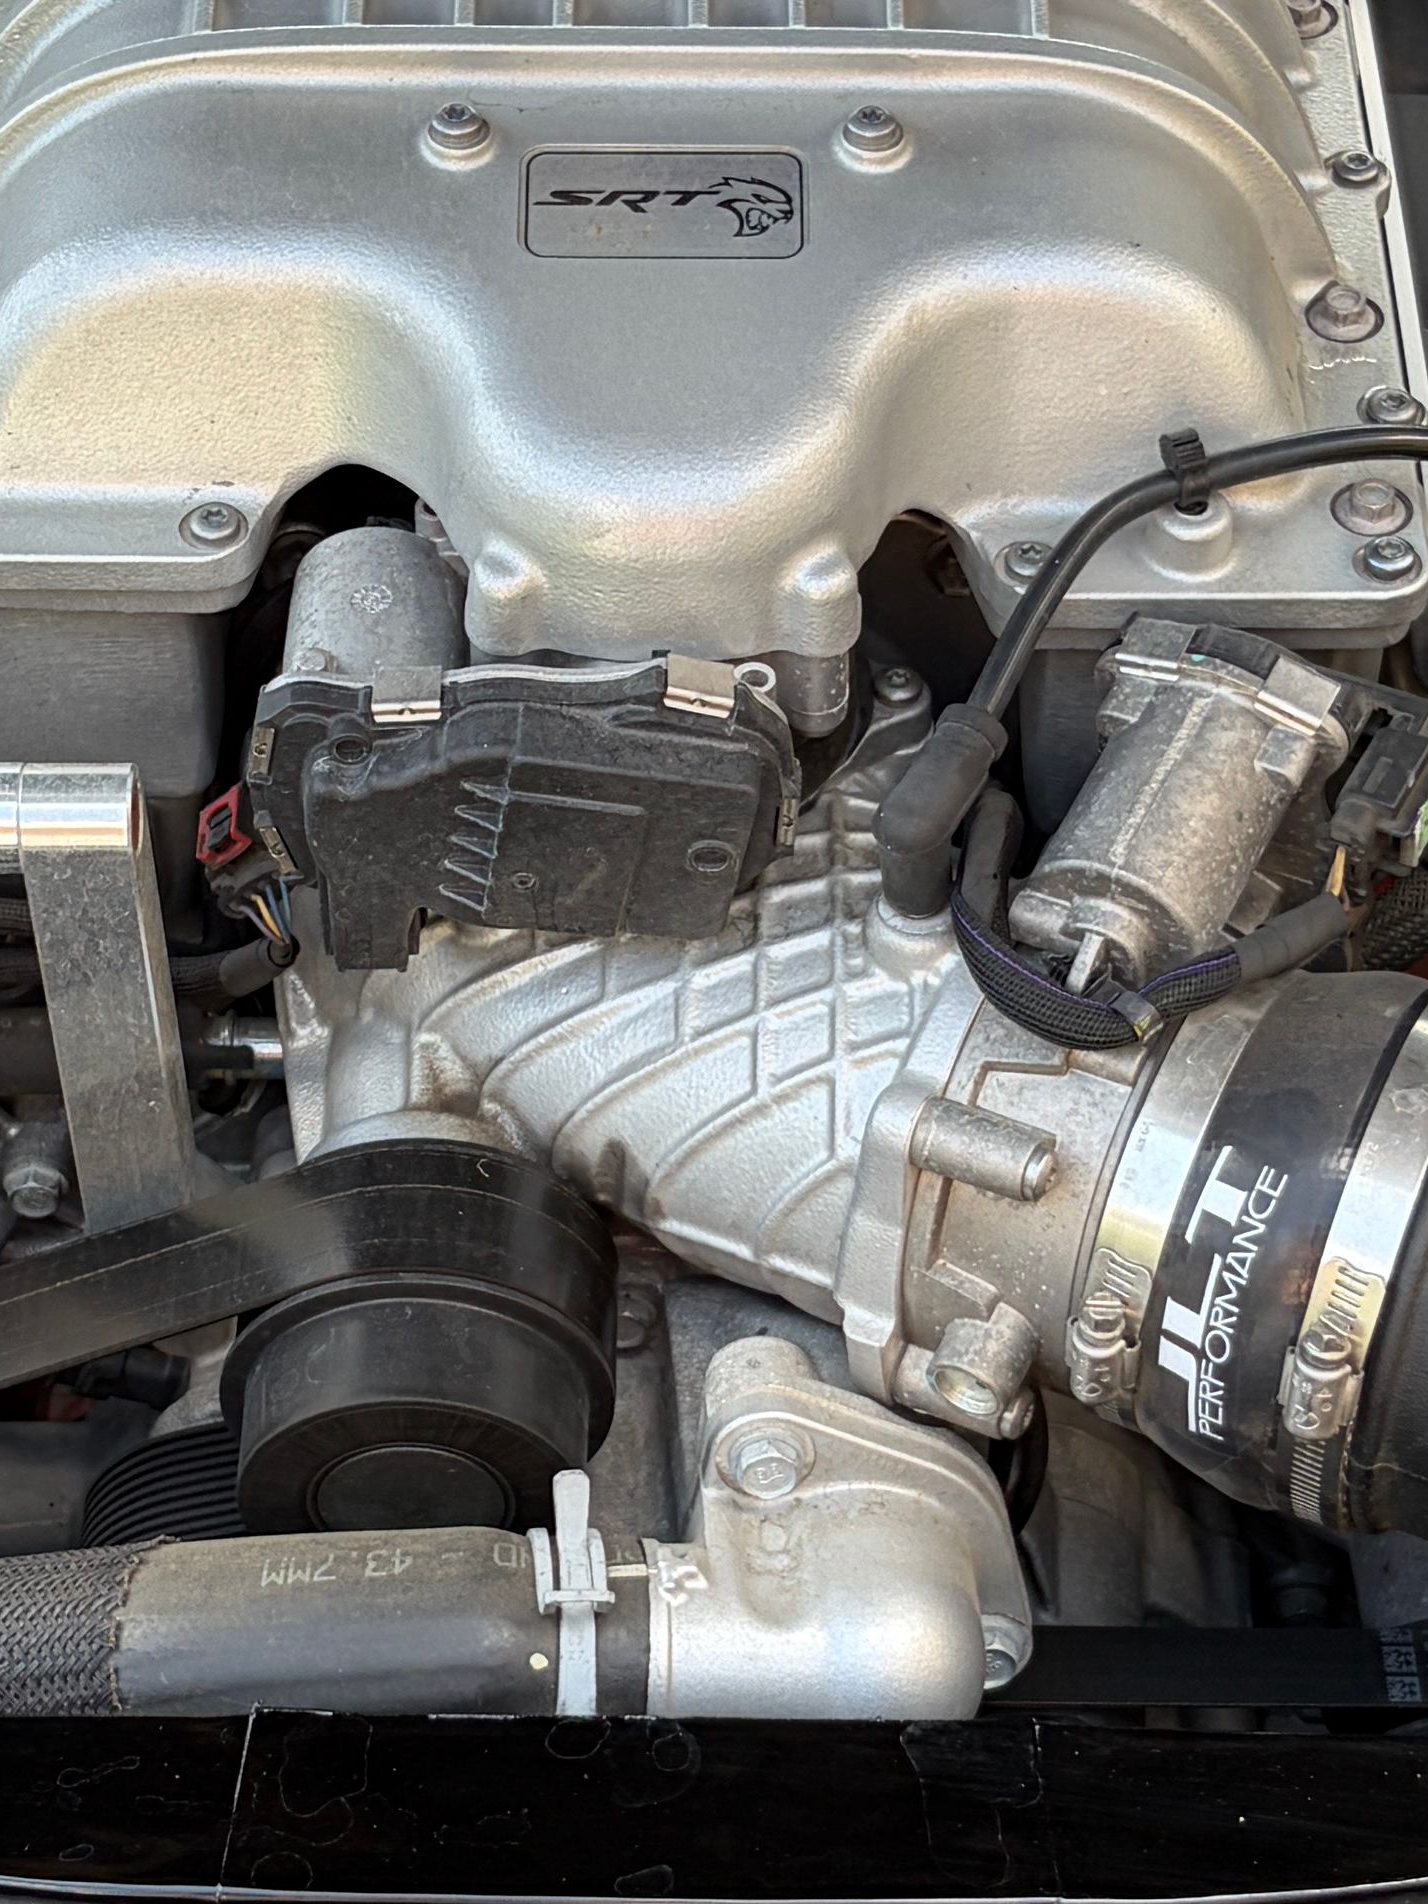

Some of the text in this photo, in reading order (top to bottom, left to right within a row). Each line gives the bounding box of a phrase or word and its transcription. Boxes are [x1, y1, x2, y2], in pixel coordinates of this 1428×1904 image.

[532, 189, 722, 214] SRT
[1157, 1145, 1249, 1434] JLT
[1197, 1165, 1289, 1441] PERFORMANCE
[260, 1547, 414, 1588] 43.7MM
